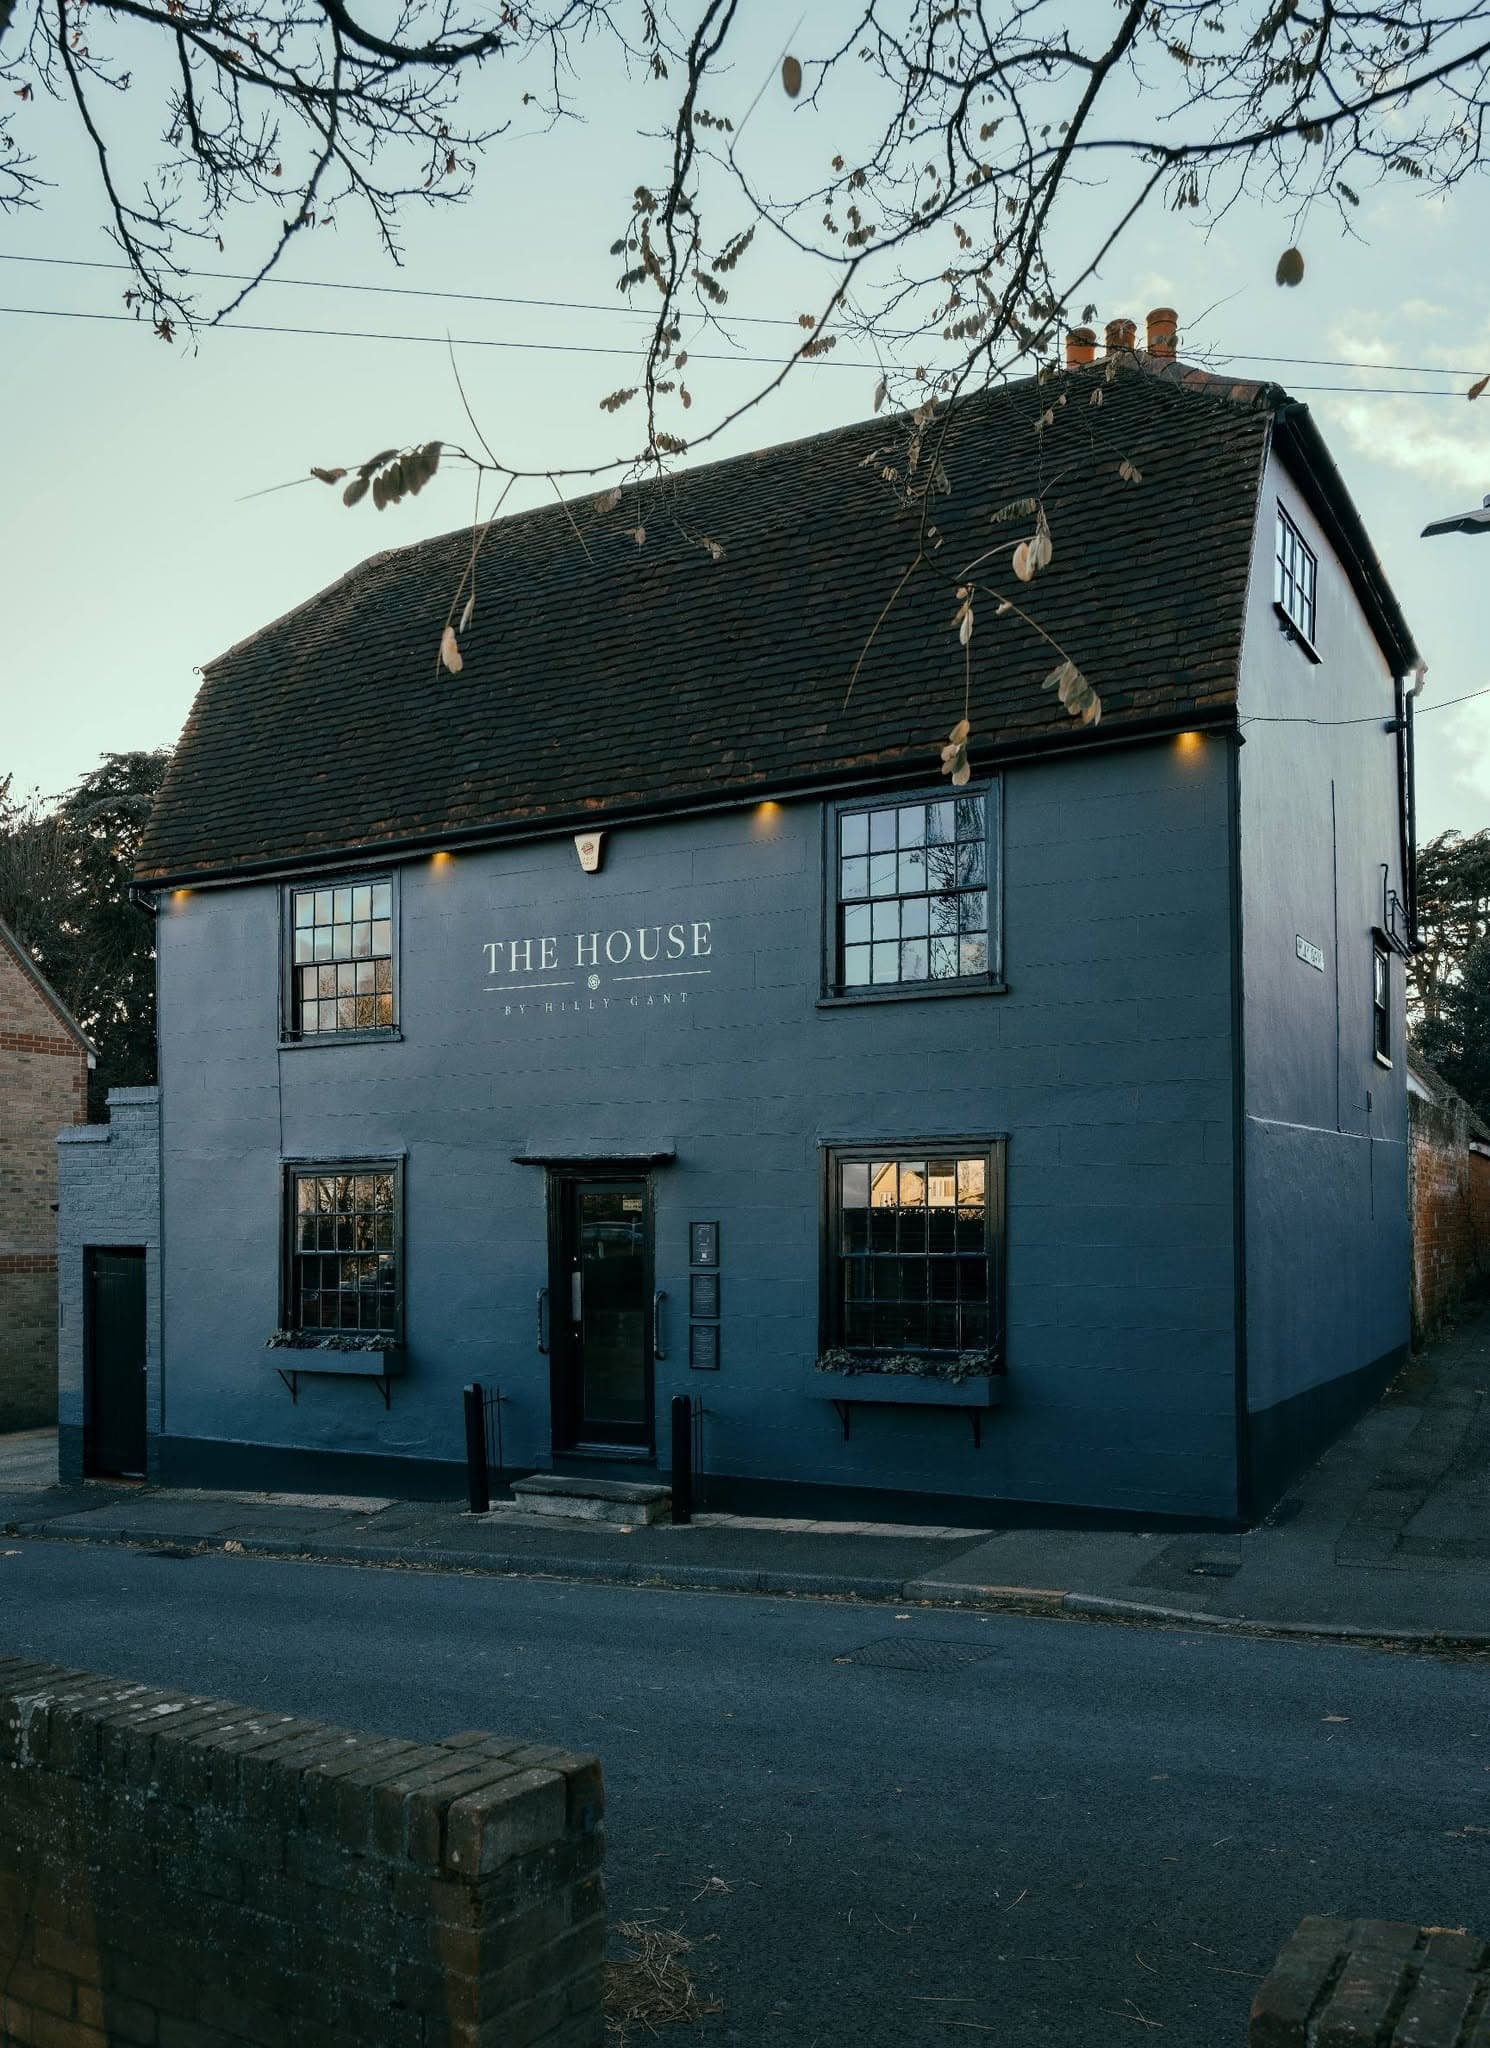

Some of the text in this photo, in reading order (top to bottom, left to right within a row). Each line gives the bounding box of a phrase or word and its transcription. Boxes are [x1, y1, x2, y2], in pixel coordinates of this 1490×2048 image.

[483, 922, 712, 974] THE HOUSE
[505, 992, 688, 1016] BY HILLY GANT
